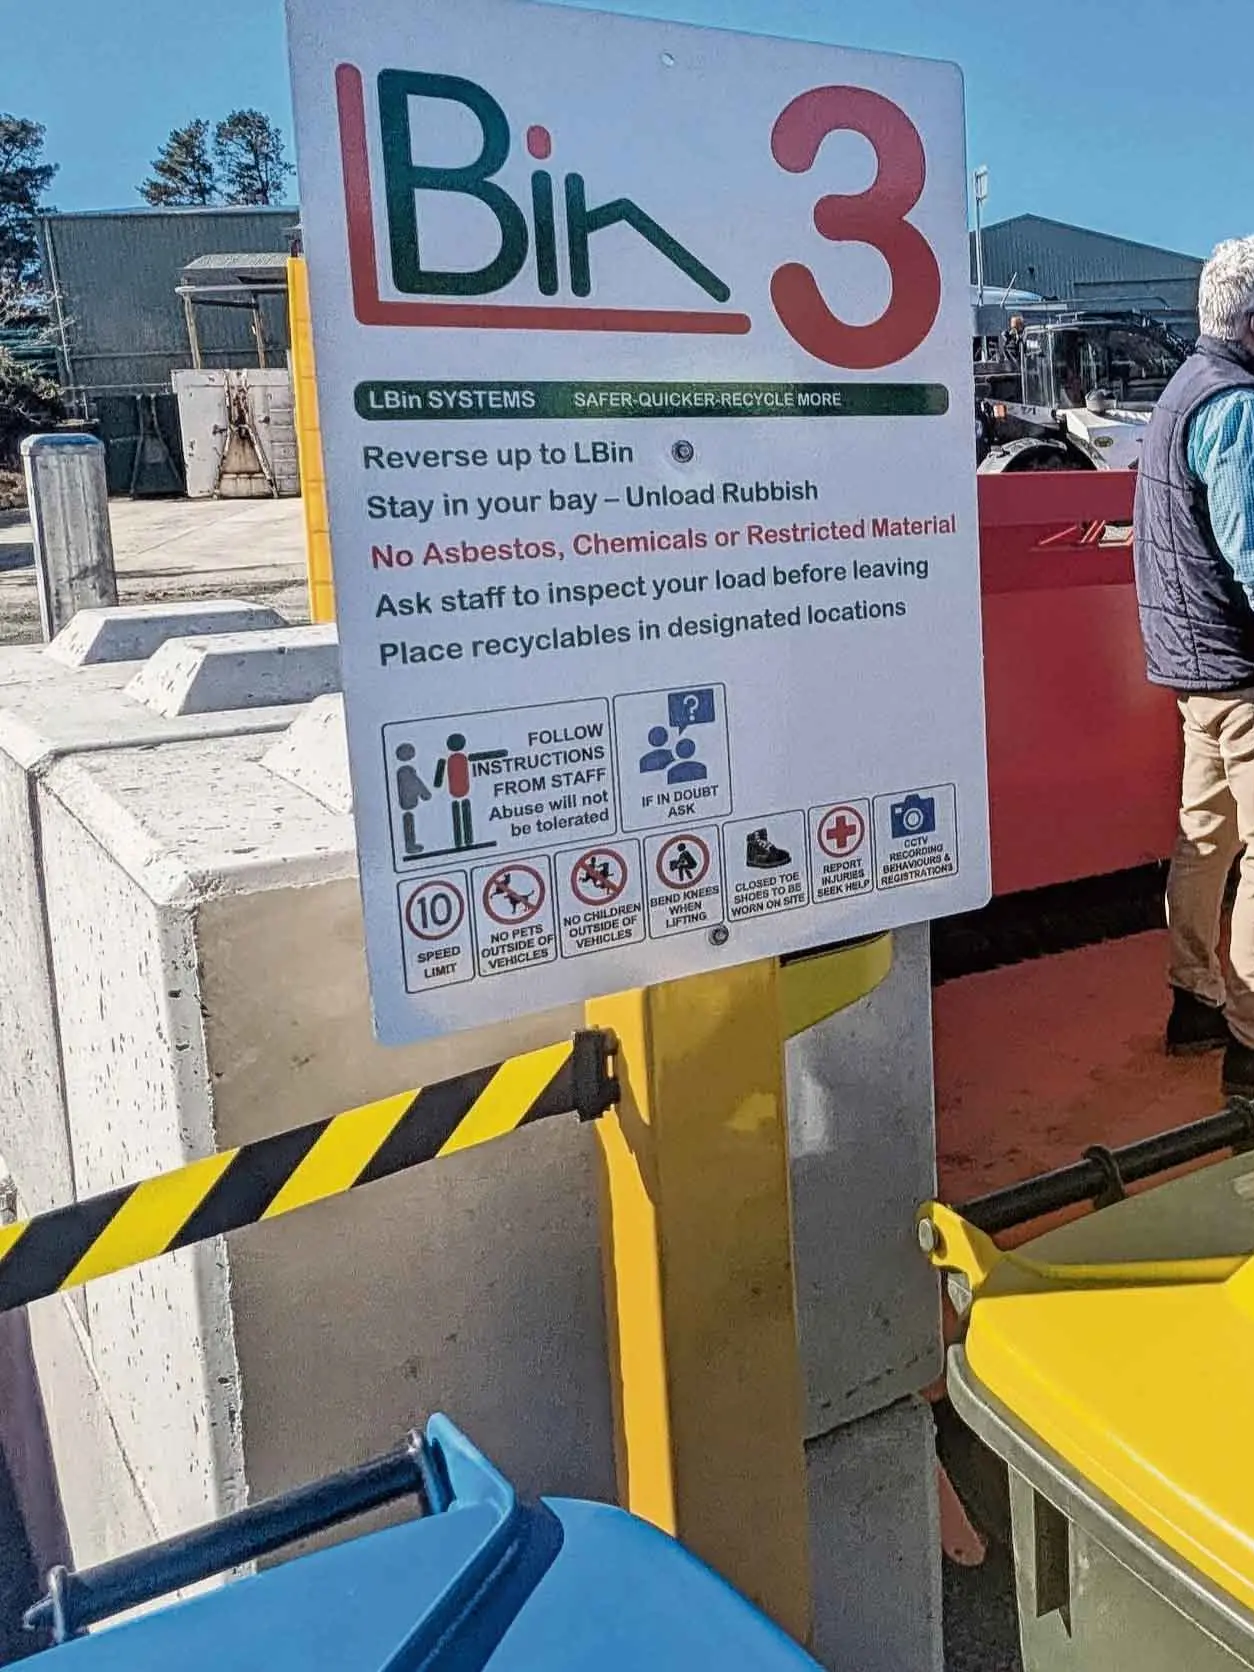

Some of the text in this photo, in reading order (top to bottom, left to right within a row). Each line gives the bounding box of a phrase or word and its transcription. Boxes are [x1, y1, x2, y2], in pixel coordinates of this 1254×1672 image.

[770, 84, 941, 370] 3
[369, 390, 536, 410] LBin SYSTEMS
[798, 391, 841, 407] MORE
[362, 442, 633, 471] Reverse up to LBin
[367, 494, 433, 523] Stay
[442, 492, 468, 516] in
[476, 492, 540, 522] your
[550, 488, 597, 516] bay
[625, 485, 714, 508] Unload
[722, 480, 818, 504] Rubbish
[371, 514, 956, 568] No Asbestos, Chemicals or Restricted Material
[375, 557, 929, 618] Ask staff to inspect your load before leaving
[379, 598, 906, 666] Place recyclables in designated locations
[528, 723, 604, 746] FOLLOW
[472, 746, 604, 776] INSTRUCTIONS
[494, 768, 606, 796] FROM STAFF
[489, 789, 608, 821] Abuse will not
[642, 785, 718, 808] IF IN DOUBT
[668, 803, 695, 817] ASK
[511, 809, 609, 837] be tolerated
[890, 844, 943, 861] RECORDING
[904, 836, 928, 848] CCTV
[823, 858, 862, 874] REPORT
[882, 863, 953, 885] REGISTRATIONS
[883, 855, 941, 874] BEHAVIOURS
[735, 872, 800, 892] CLOSED TOE
[822, 869, 865, 885] INJURIES
[650, 885, 719, 907] BEND KNEES
[734, 883, 801, 904] SHOES TO BE
[818, 879, 870, 897] SEEK HELP
[417, 893, 452, 929] 10
[563, 902, 641, 927] NO CHILDREN
[669, 902, 702, 915] WHEN
[731, 893, 805, 916] WORN ON SITE
[569, 916, 637, 937] OUTSIDE OF
[666, 912, 707, 928] LIFTING
[490, 924, 544, 944] NO PETS
[575, 929, 633, 948] VEHICLES
[417, 946, 461, 963] SPEED
[481, 935, 554, 958] OUTSIDE OF
[488, 949, 548, 969] VEHICLES
[424, 963, 457, 978] LIMIT
